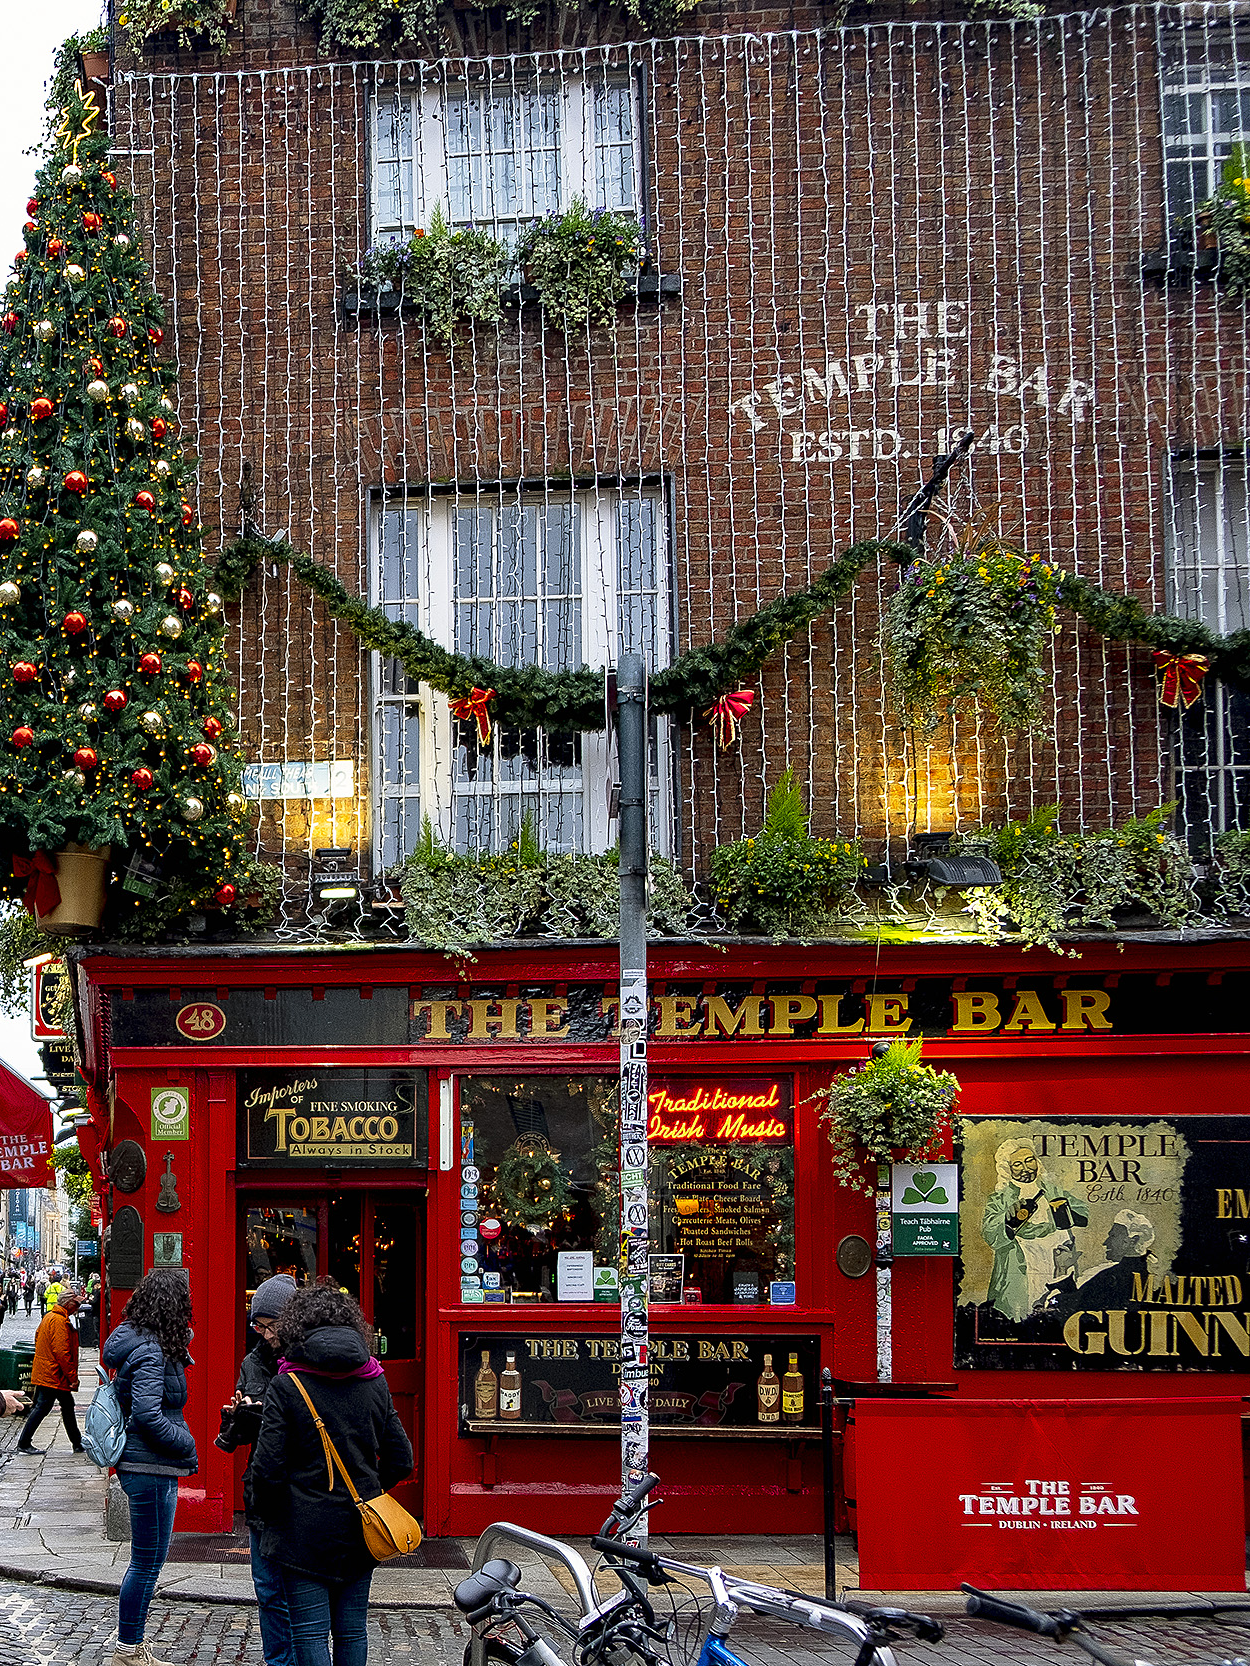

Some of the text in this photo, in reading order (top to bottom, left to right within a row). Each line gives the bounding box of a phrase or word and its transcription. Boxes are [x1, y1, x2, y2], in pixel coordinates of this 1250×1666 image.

[854, 301, 969, 341] THE
[730, 348, 1097, 430] TEMPLE BAR
[788, 424, 1030, 462] ESTD. 1840
[335, 771, 347, 788] 2
[184, 1008, 215, 1031] 48
[411, 998, 571, 1039] THE
[950, 990, 1113, 1033] BAR
[244, 1078, 318, 1108] Importers
[290, 1095, 304, 1104] OF
[648, 1084, 780, 1113] Traditional
[310, 1101, 398, 1112] FINE SMOKING
[264, 1108, 399, 1152] TOBACCO
[647, 1115, 705, 1138] Irish
[716, 1113, 786, 1138] Music
[0, 1134, 28, 1145] THE
[1032, 1134, 1179, 1158] TEMPLE
[291, 1144, 410, 1155] Always in Stock
[0, 1156, 35, 1171] BAR
[667, 1155, 762, 1180] TEMPLE BAR
[1076, 1159, 1147, 1185] BAR
[667, 1182, 762, 1190] Traditional Food Fare
[1136, 1186, 1176, 1202] 1840
[713, 1194, 738, 1202] Cheese
[740, 1194, 761, 1202] Board
[714, 1205, 741, 1213] Smoked
[743, 1205, 770, 1213] Salmon
[672, 1216, 761, 1225] Charcuterie Meats, Olives
[682, 1227, 751, 1235] Toasted Sandwiches
[680, 1238, 753, 1246] Hot Roast Beef Rolls
[1129, 1272, 1243, 1306] MALTED
[1062, 1310, 1250, 1356] GUINN
[525, 1339, 752, 1362] THE TEPLE BAR
[624, 1367, 649, 1378] imbue
[759, 1386, 778, 1396] D.W.D.
[587, 1398, 613, 1408] LIVE
[1024, 1479, 1070, 1495] THE
[958, 1494, 1139, 1515] TEMPLE BAR
[999, 1520, 1097, 1529] DUBLIN IRELAND
